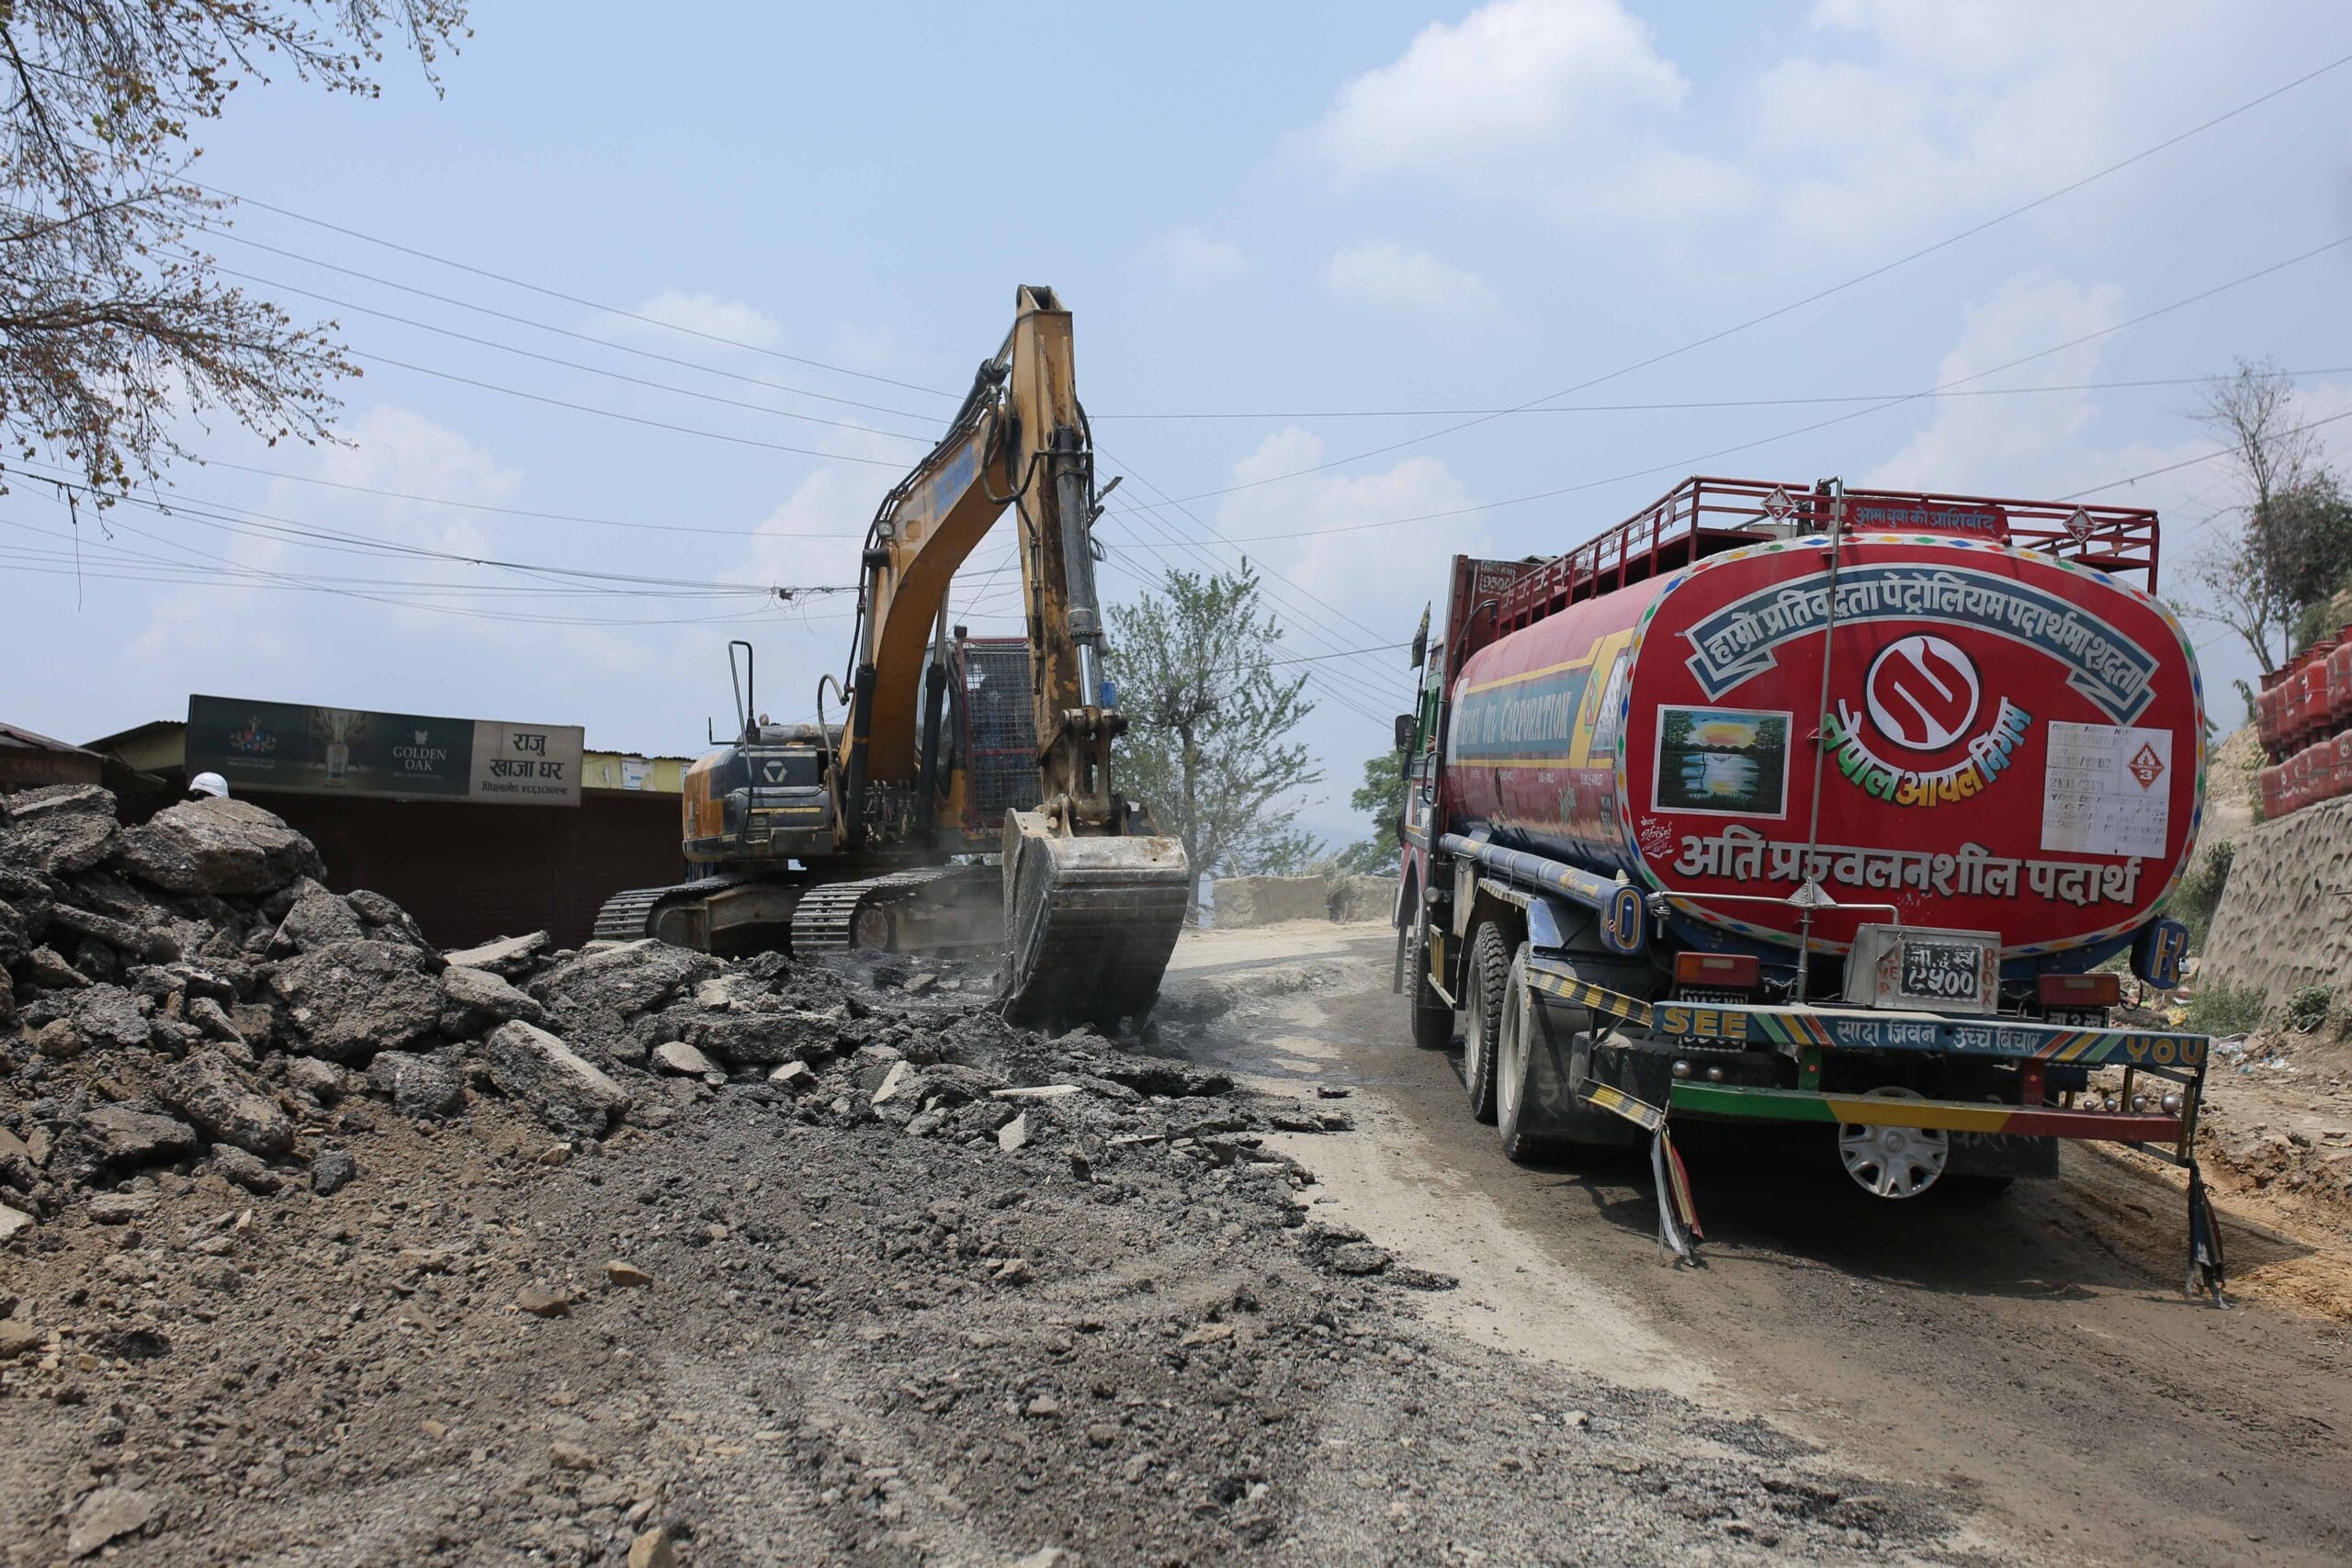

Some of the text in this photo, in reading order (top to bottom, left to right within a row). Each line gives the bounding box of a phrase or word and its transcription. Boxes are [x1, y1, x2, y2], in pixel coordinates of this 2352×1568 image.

[1881, 571, 2008, 621] पेट्रोलियम
[2007, 595, 2092, 656] पदार्थमा
[393, 746, 447, 761] GOLDEN
[513, 733, 548, 757] राजु
[1895, 759, 1985, 807] आयल
[1969, 696, 2032, 784] निगम
[405, 759, 433, 772] OAK
[490, 759, 565, 780] खाजा घर
[1674, 824, 2143, 907] अति प्रज्वलनशील पदार्थ
[1662, 1008, 1747, 1039] SEE
[1837, 1021, 1880, 1047] सादा
[1954, 1026, 1994, 1049] उच्च
[2126, 1035, 2205, 1066] YOU
